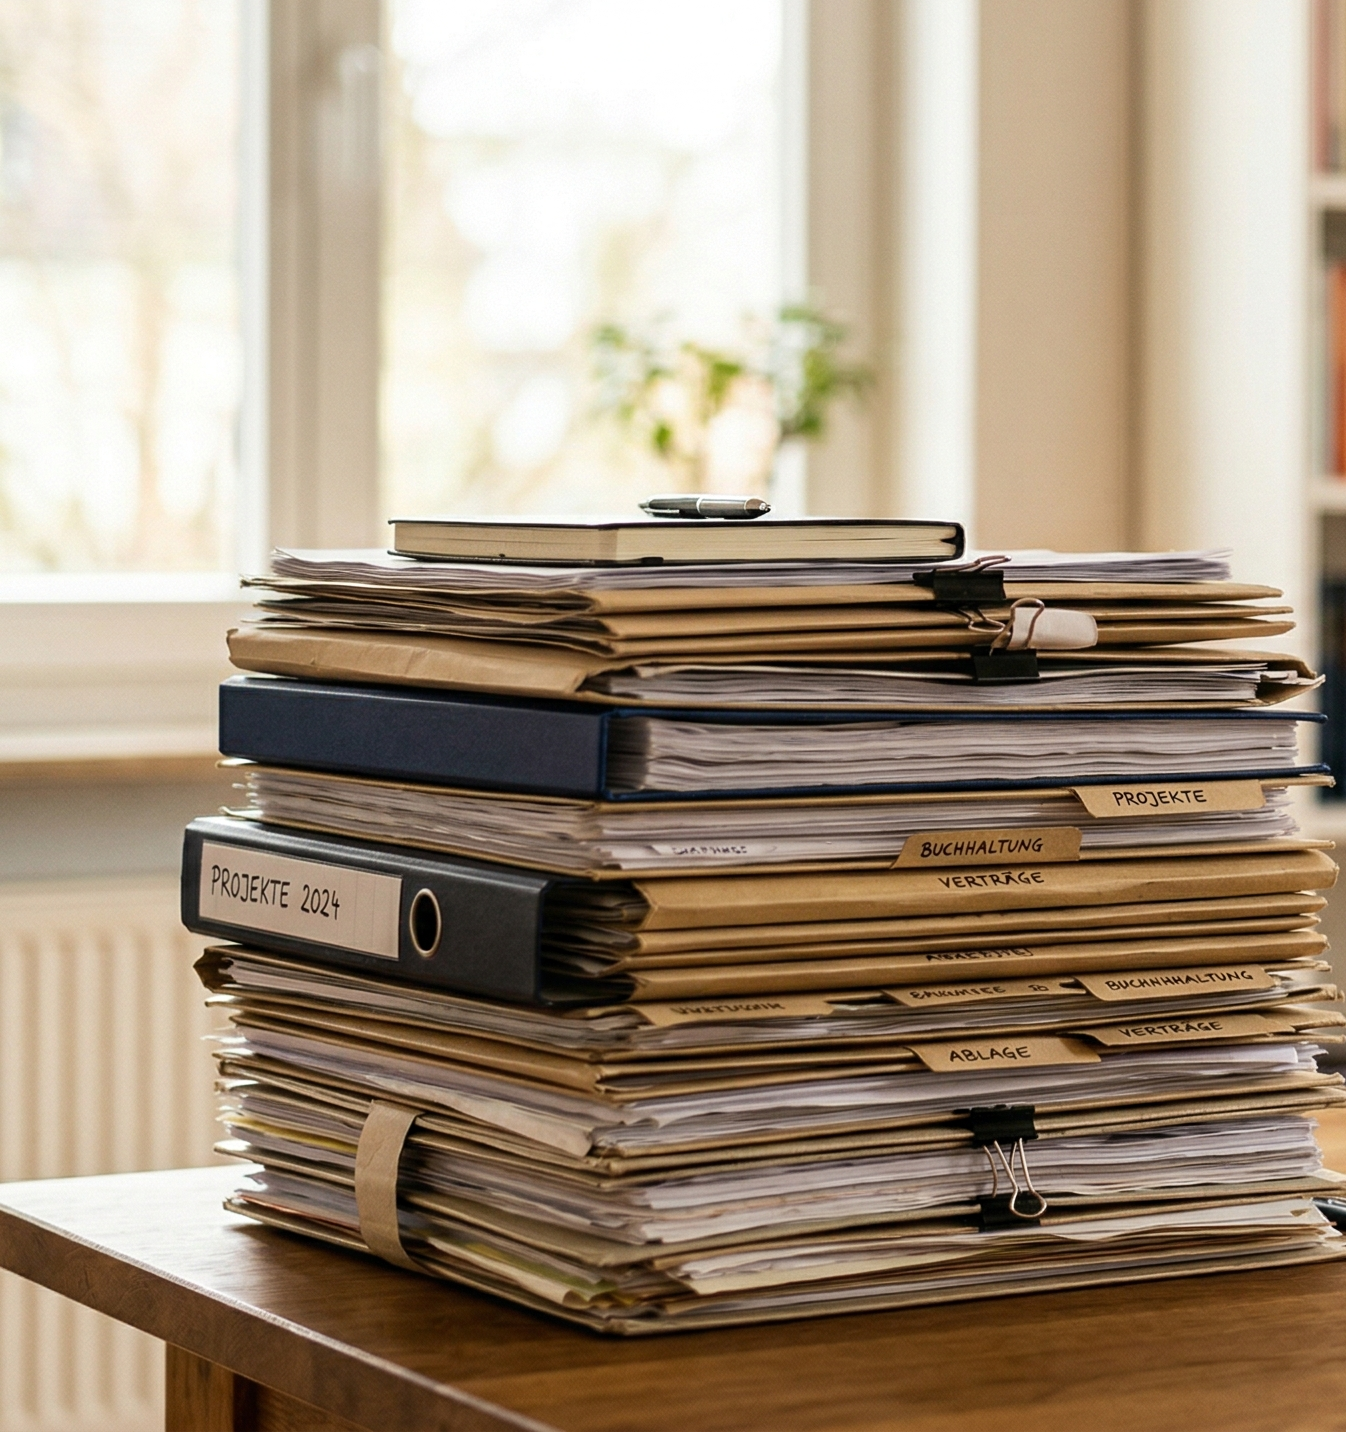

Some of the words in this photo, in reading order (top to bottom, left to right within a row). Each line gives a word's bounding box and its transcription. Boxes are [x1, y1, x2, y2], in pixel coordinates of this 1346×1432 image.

[1112, 789, 1207, 807] PROJEKTE
[920, 837, 1043, 858] BUCHHALTUNG
[211, 864, 291, 909] PROJEKTE
[299, 884, 341, 920] 2024
[1118, 1019, 1224, 1038] VERTRÄGE
[949, 1046, 1031, 1062] ABLAGE
